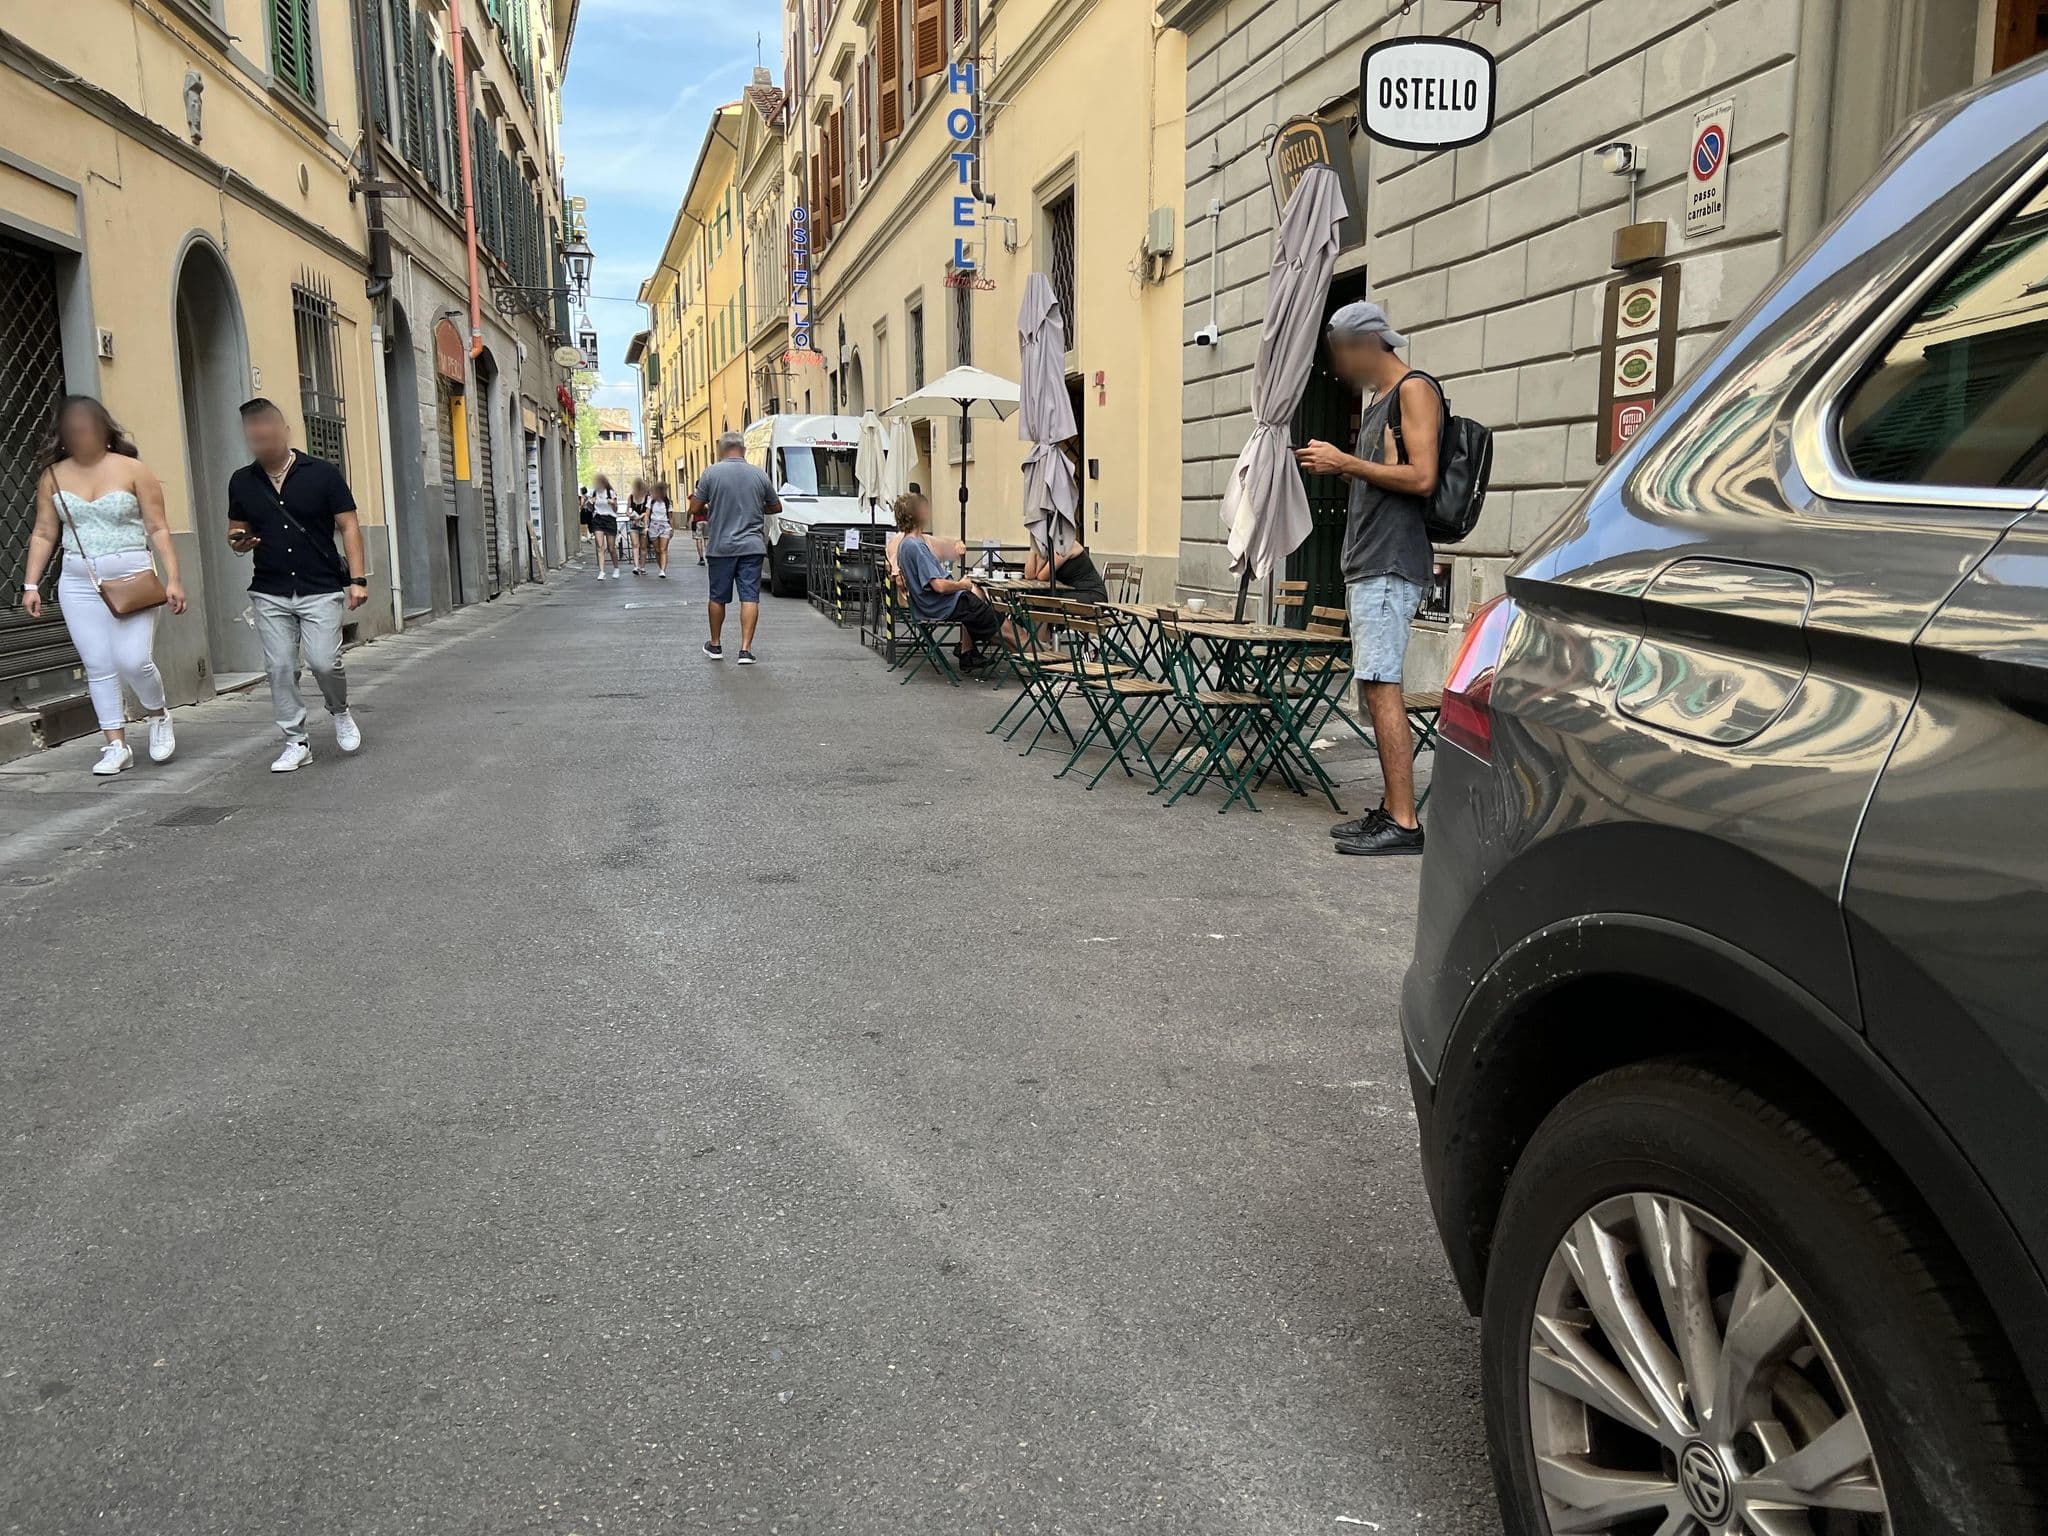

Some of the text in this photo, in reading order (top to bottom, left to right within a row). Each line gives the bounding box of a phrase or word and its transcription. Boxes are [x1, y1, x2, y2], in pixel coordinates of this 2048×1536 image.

[1379, 76, 1477, 111] OSTELLO
[948, 63, 976, 269] HOTEL
[1281, 136, 1319, 174] OSTELLO
[1688, 201, 1721, 221] carrabile
[1693, 187, 1716, 205] passo
[792, 207, 809, 347] OSTELLO
[1623, 413, 1641, 425] OSTELLO
